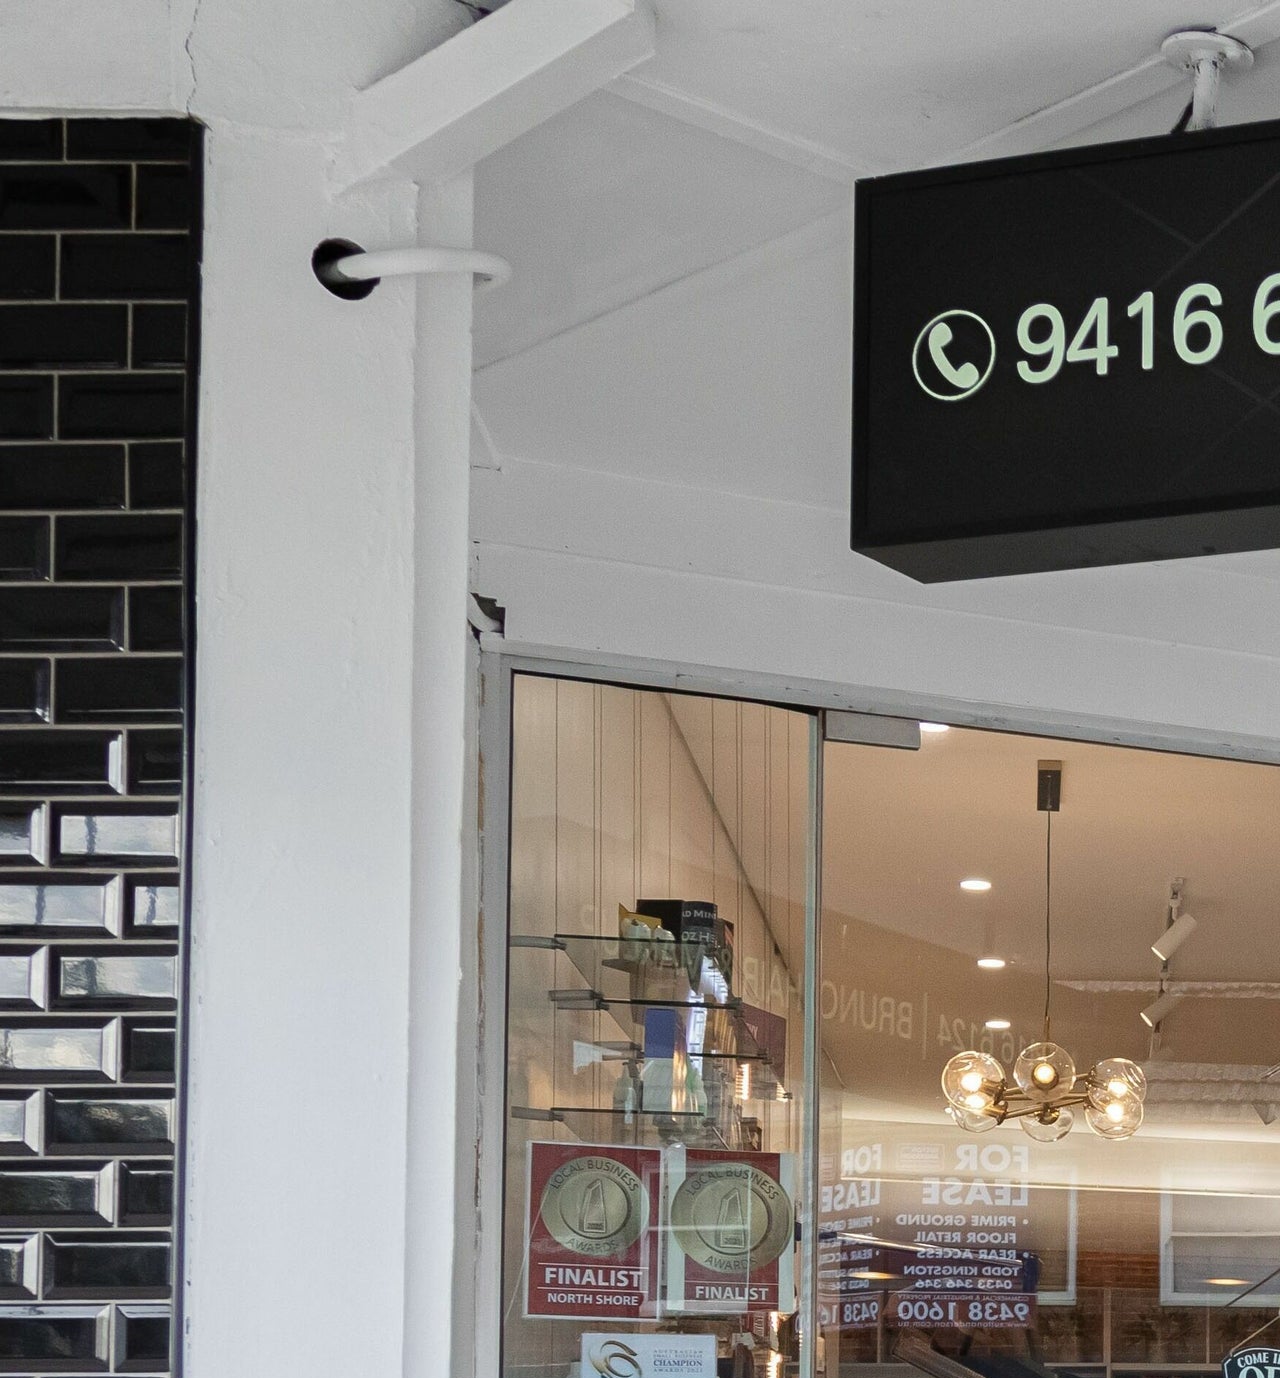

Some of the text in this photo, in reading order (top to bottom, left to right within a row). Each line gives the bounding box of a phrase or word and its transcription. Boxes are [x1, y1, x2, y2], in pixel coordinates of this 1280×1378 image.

[1016, 283, 1224, 384] 9416
[551, 1160, 640, 1193] LOCAL BUSINESS
[686, 1168, 780, 1201] LOCAL BUSINESS
[544, 1267, 643, 1288] FINALIST
[547, 1293, 640, 1307] NORTH SHORE
[695, 1286, 769, 1301] FINALIST
[1237, 1352, 1270, 1368] COME
